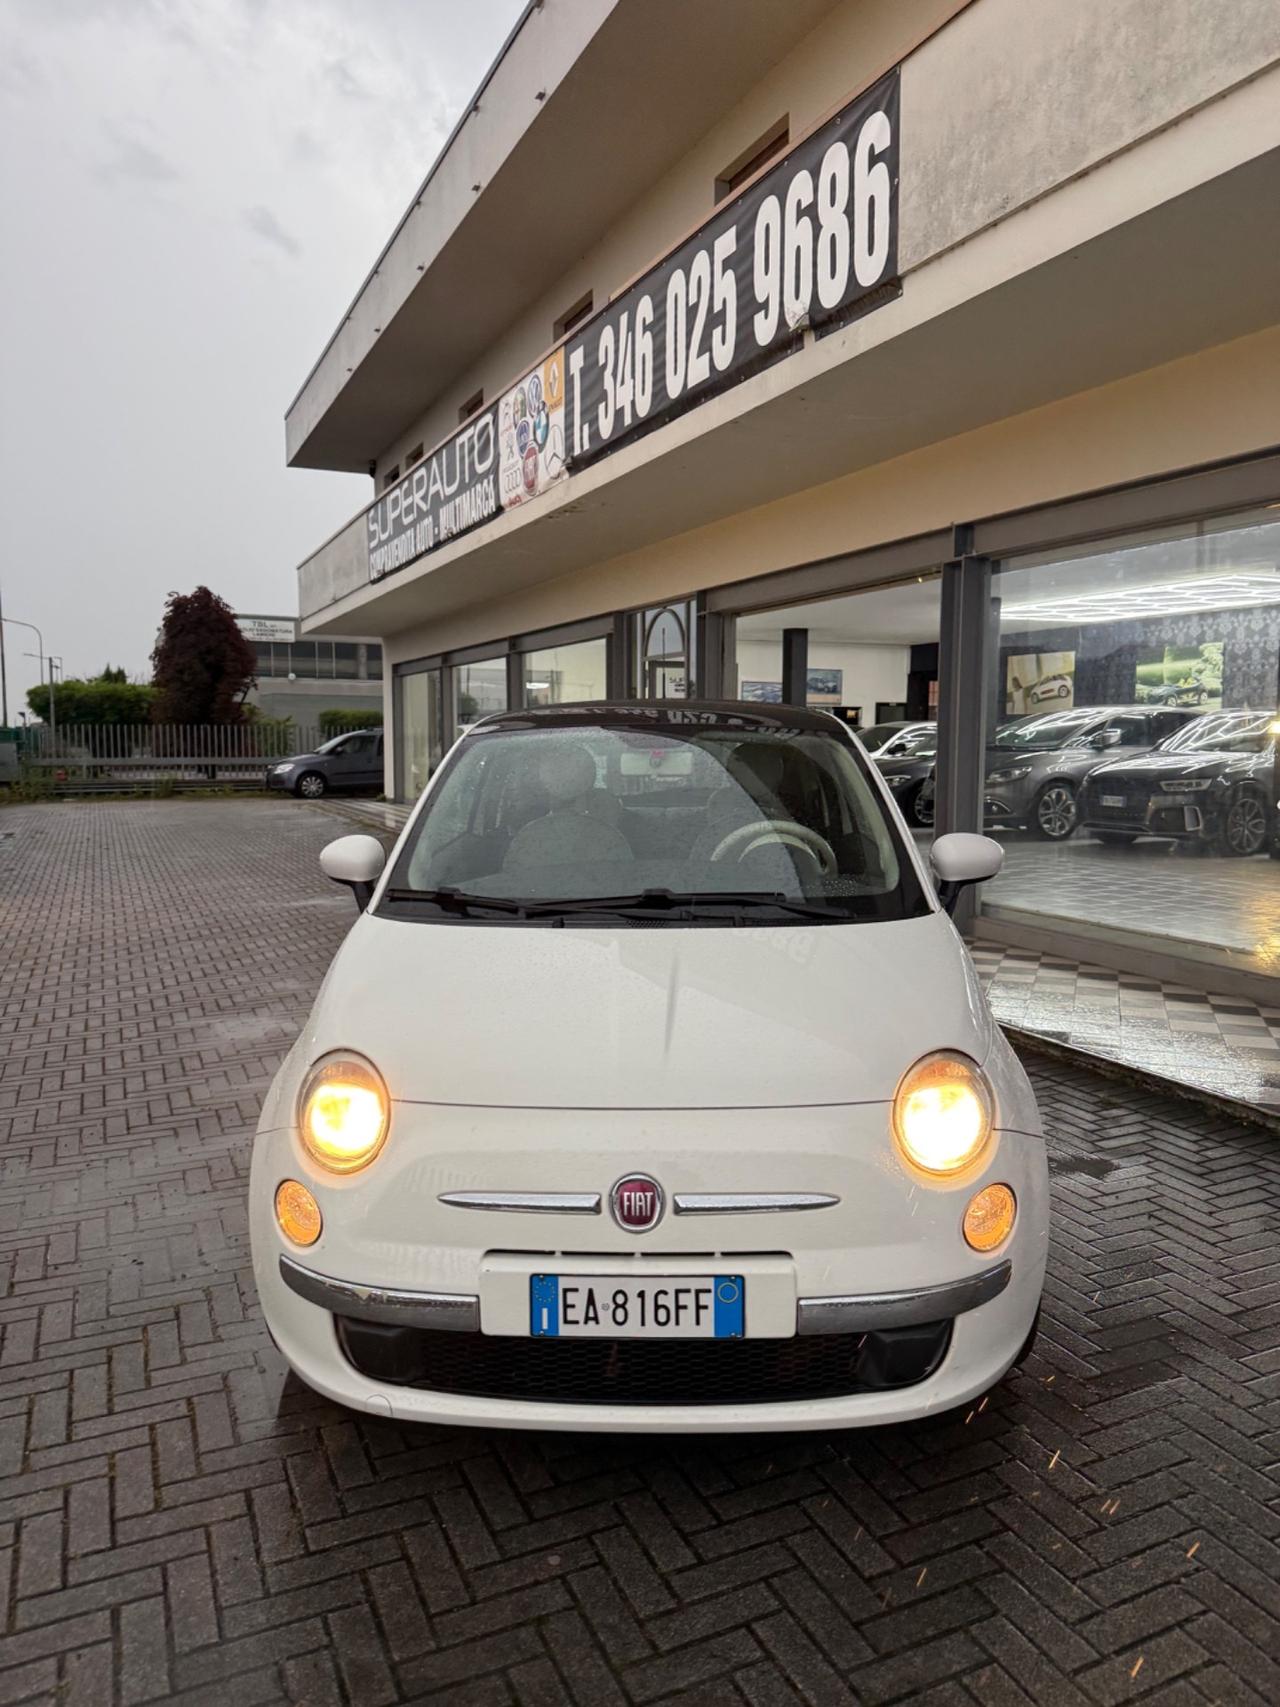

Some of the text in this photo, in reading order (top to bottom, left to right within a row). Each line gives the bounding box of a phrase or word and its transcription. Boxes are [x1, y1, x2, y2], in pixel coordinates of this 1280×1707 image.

[569, 110, 891, 456] T. 346 025 9686
[368, 412, 495, 549] SUPERAUTO
[415, 514, 434, 556] AUTO
[439, 474, 496, 542] MULTIMARCA
[622, 1191, 654, 1217] FIAT
